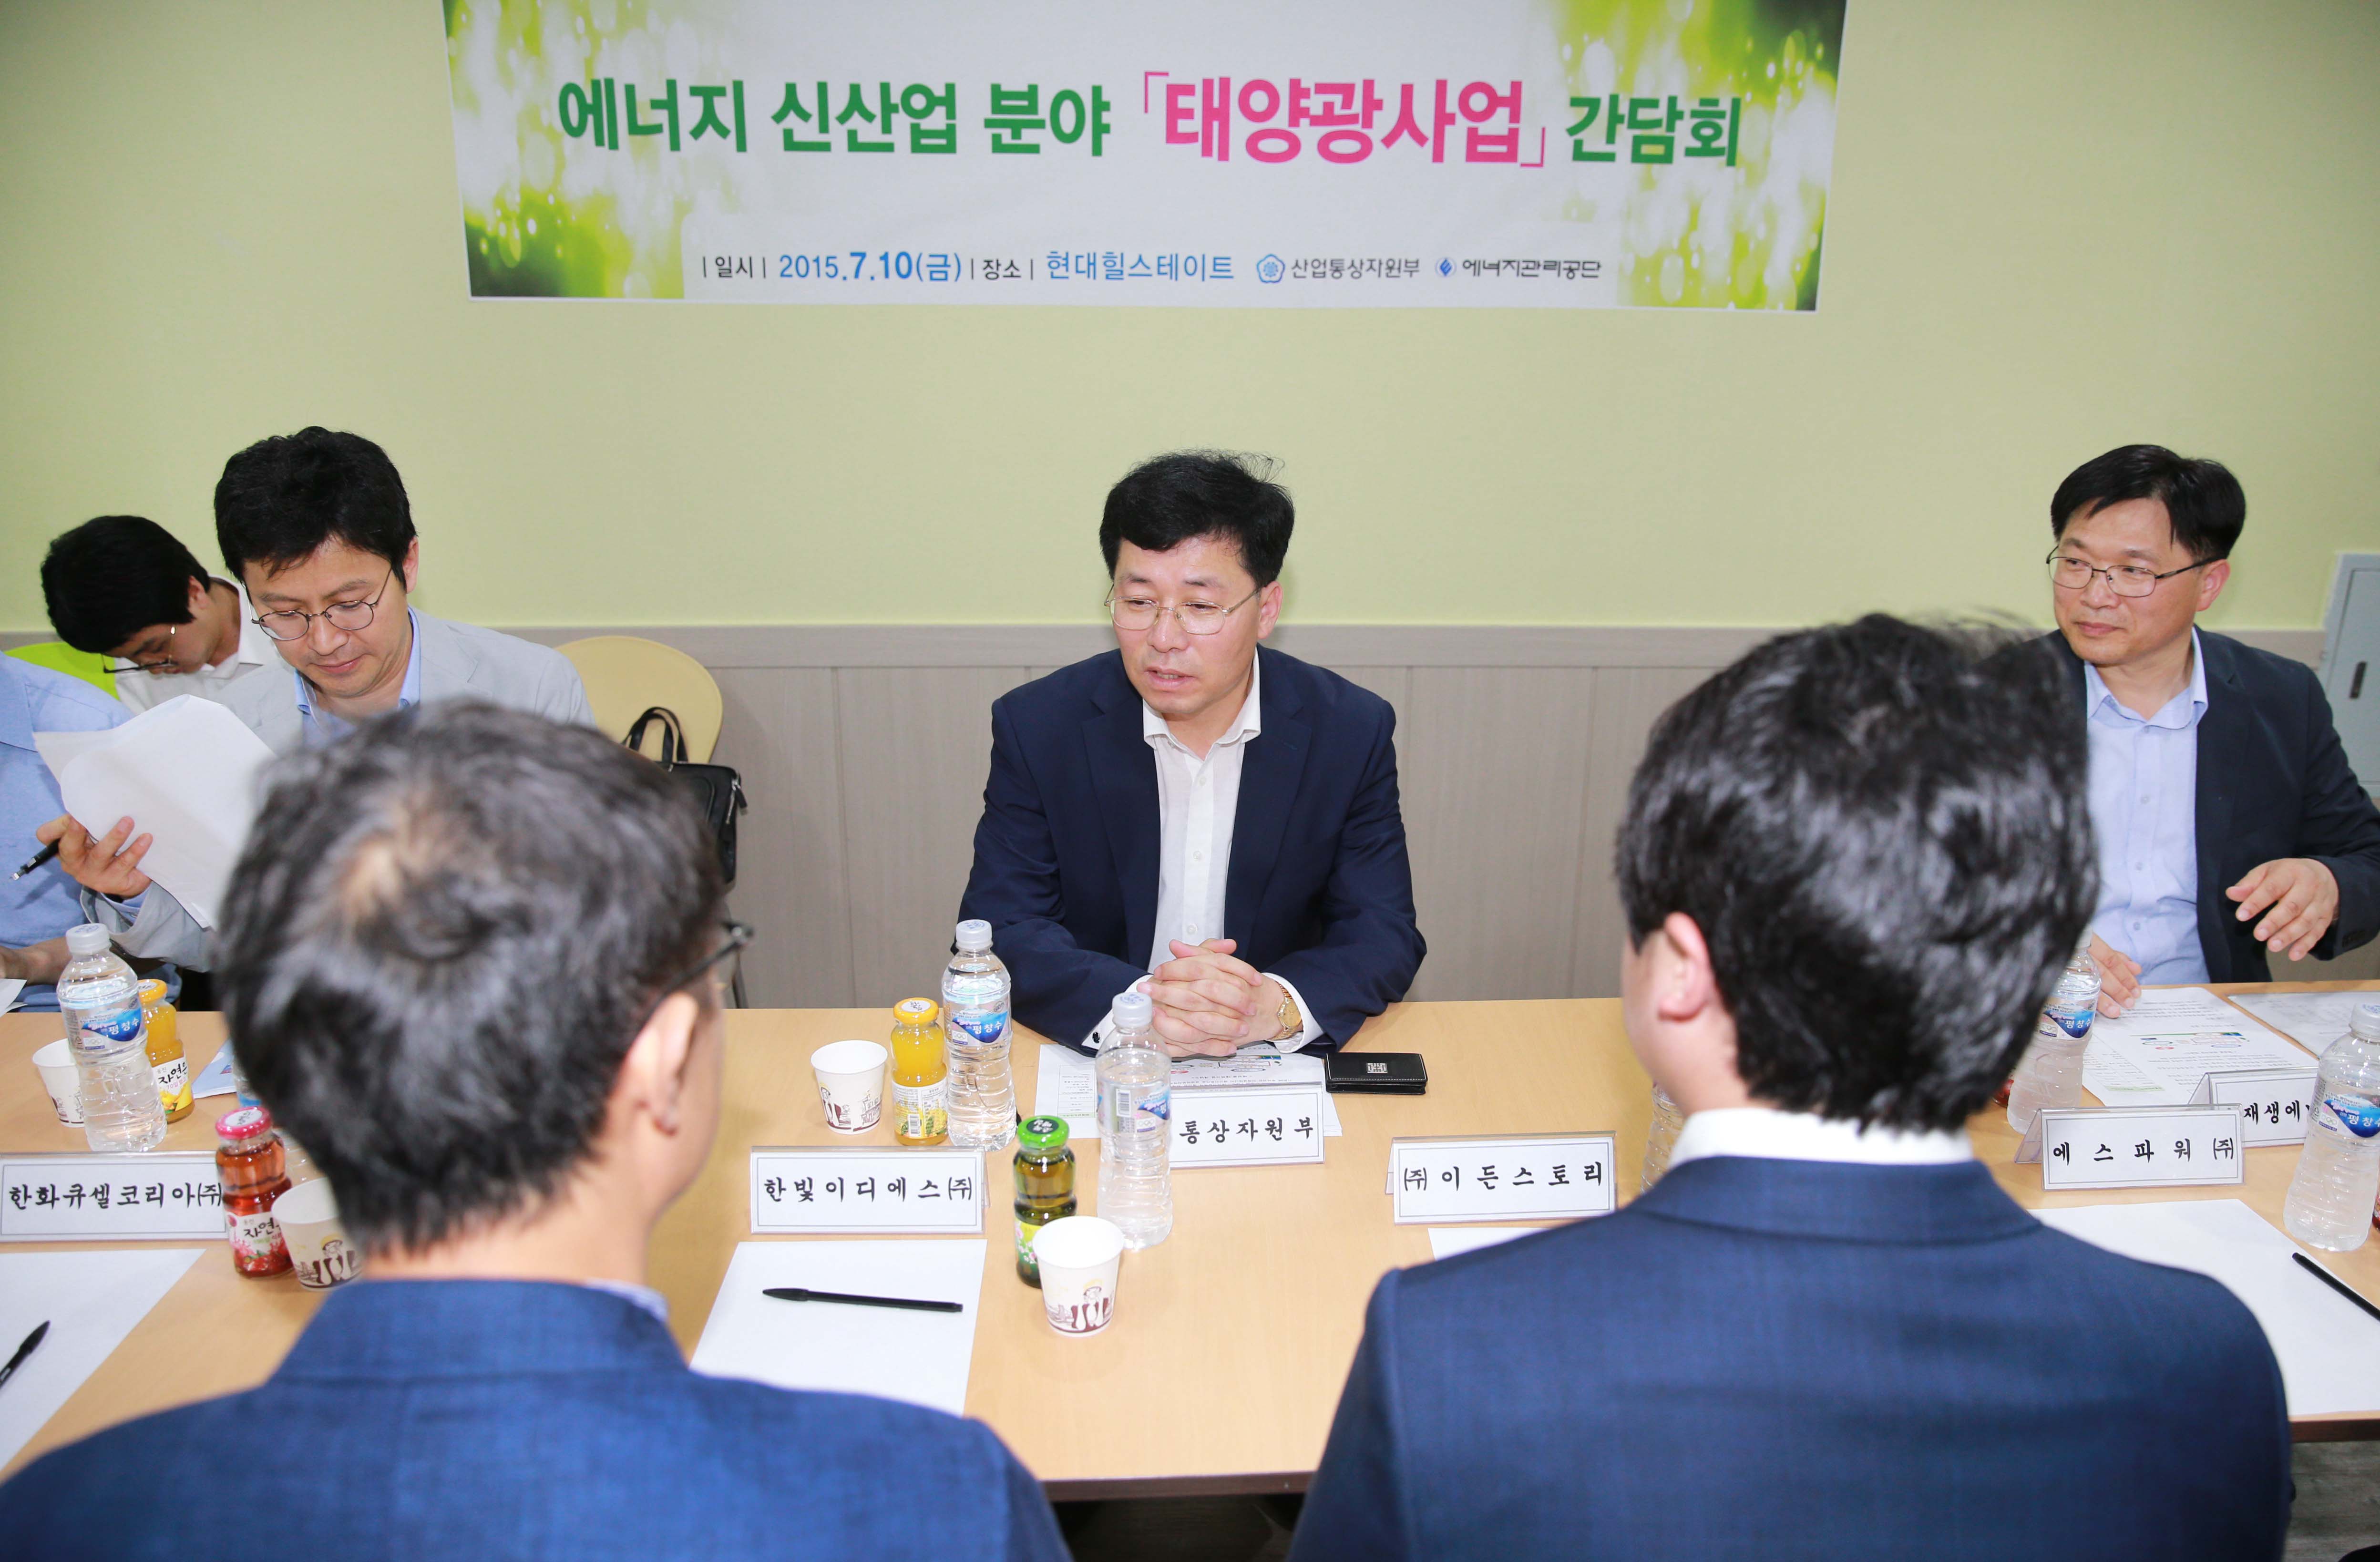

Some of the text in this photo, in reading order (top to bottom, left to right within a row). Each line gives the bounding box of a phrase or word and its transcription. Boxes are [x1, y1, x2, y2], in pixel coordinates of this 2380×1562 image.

[559, 71, 1742, 168] 에너지 신산업 분야 「태양광사업」 간담회
[715, 251, 1234, 282] 일시 2015.7.10(금) 장소 현대힐스테이트
[1291, 257, 1421, 279] 산업통상자원부
[1462, 259, 1601, 280] 에너지관리공단
[973, 1021, 1002, 1035] 평창수
[2244, 1100, 2311, 1125] 재생에
[1179, 1117, 1313, 1144] 통상자원부
[244, 1216, 282, 1238] 자연
